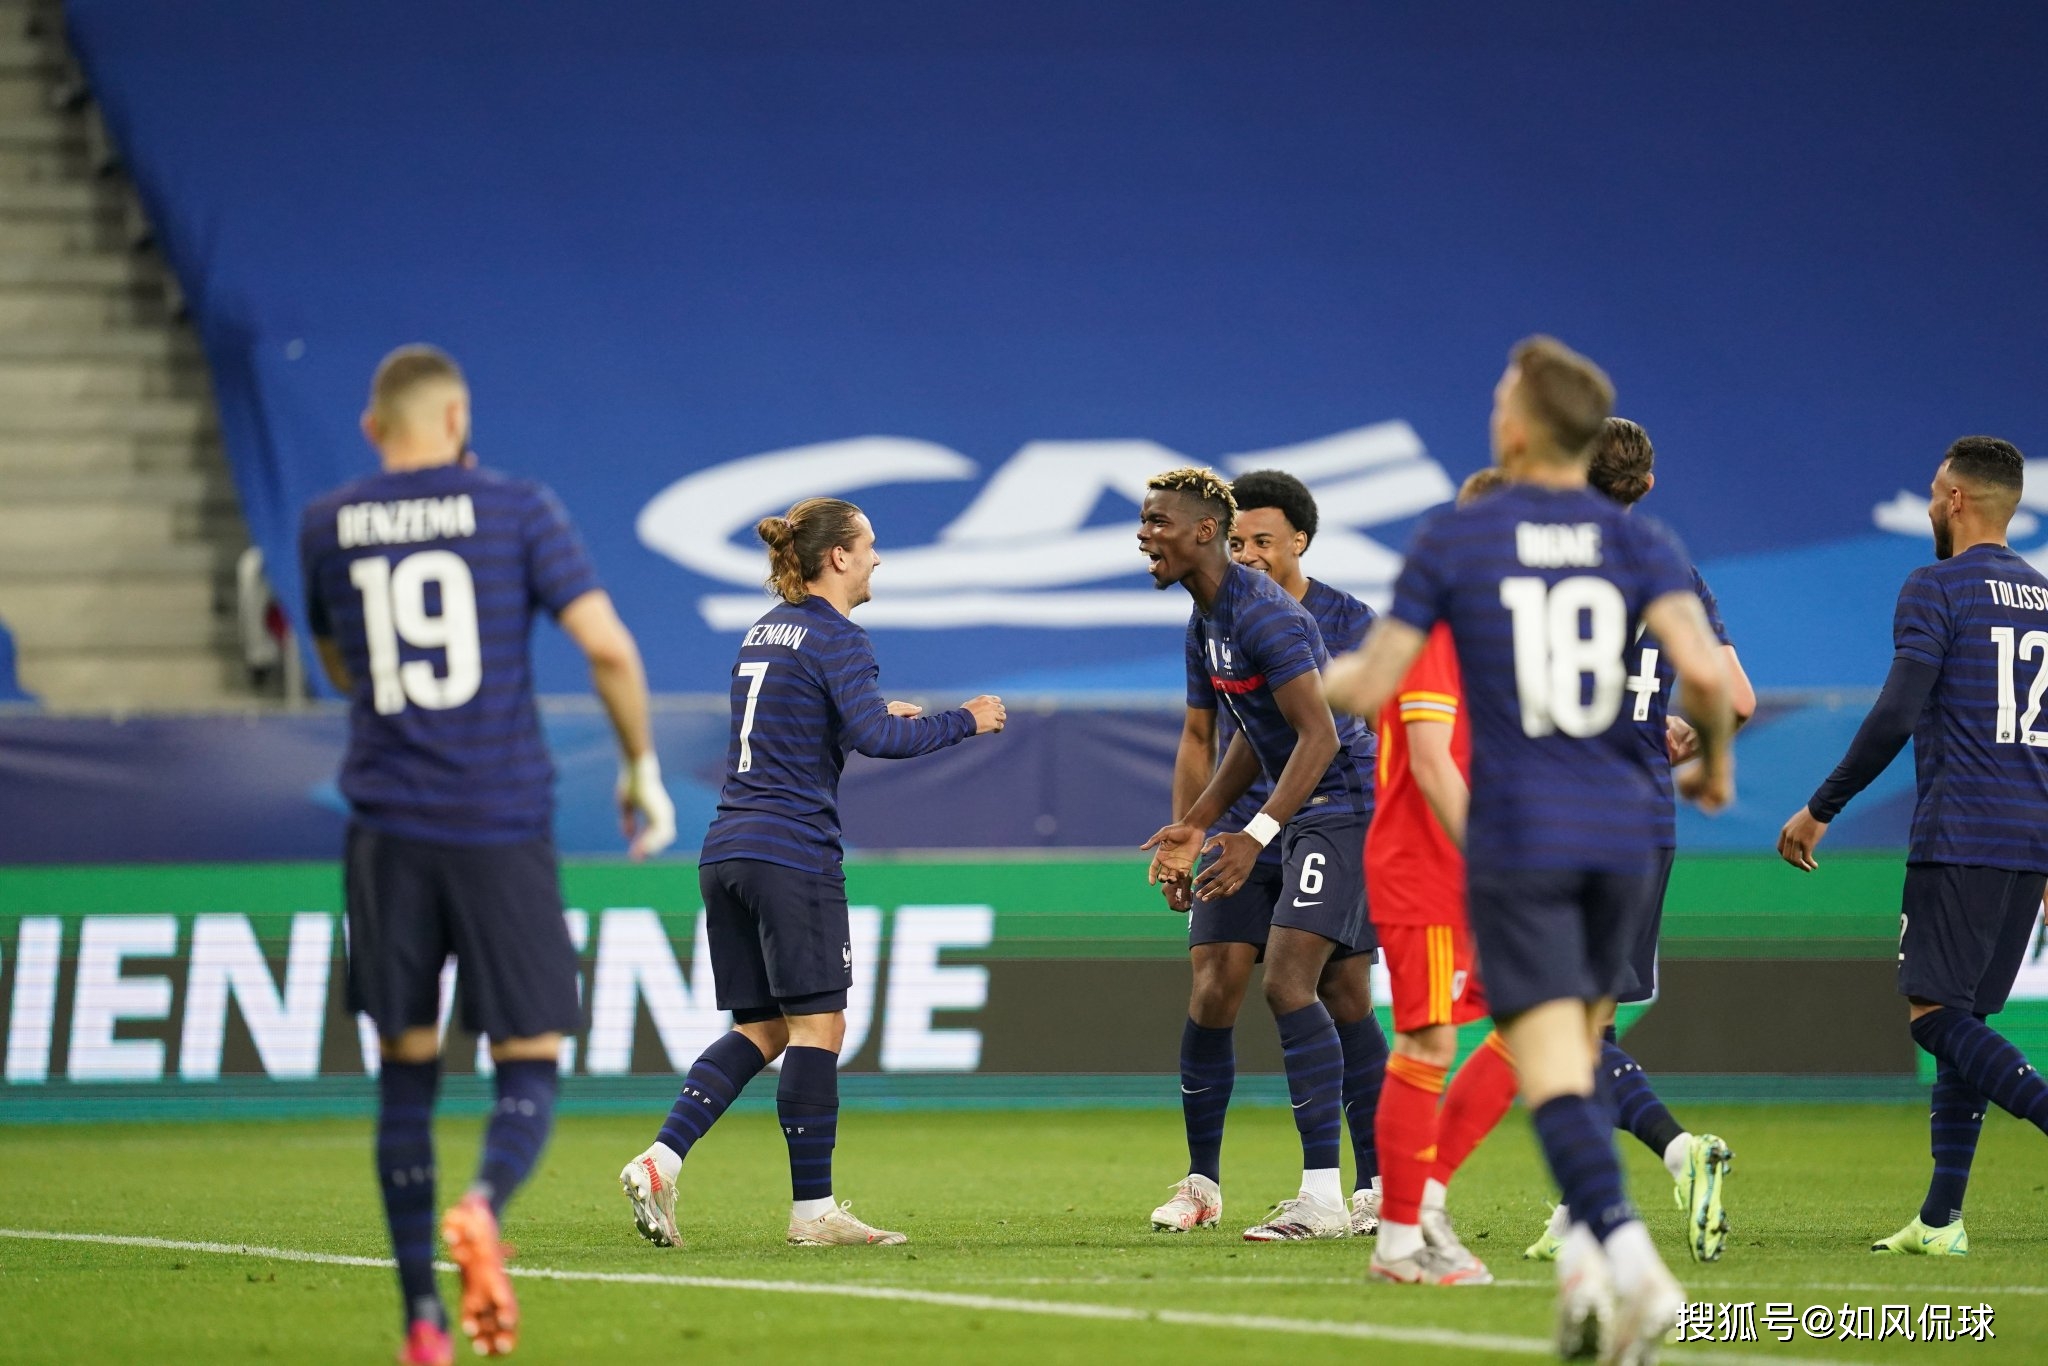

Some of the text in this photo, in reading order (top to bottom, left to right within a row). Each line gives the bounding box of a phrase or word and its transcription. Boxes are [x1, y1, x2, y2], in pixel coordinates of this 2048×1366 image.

[350, 549, 482, 715] 19
[1500, 575, 1627, 739] 18
[1991, 627, 2048, 747] 12
[738, 662, 769, 773] 7
[1299, 853, 1326, 894] 6
